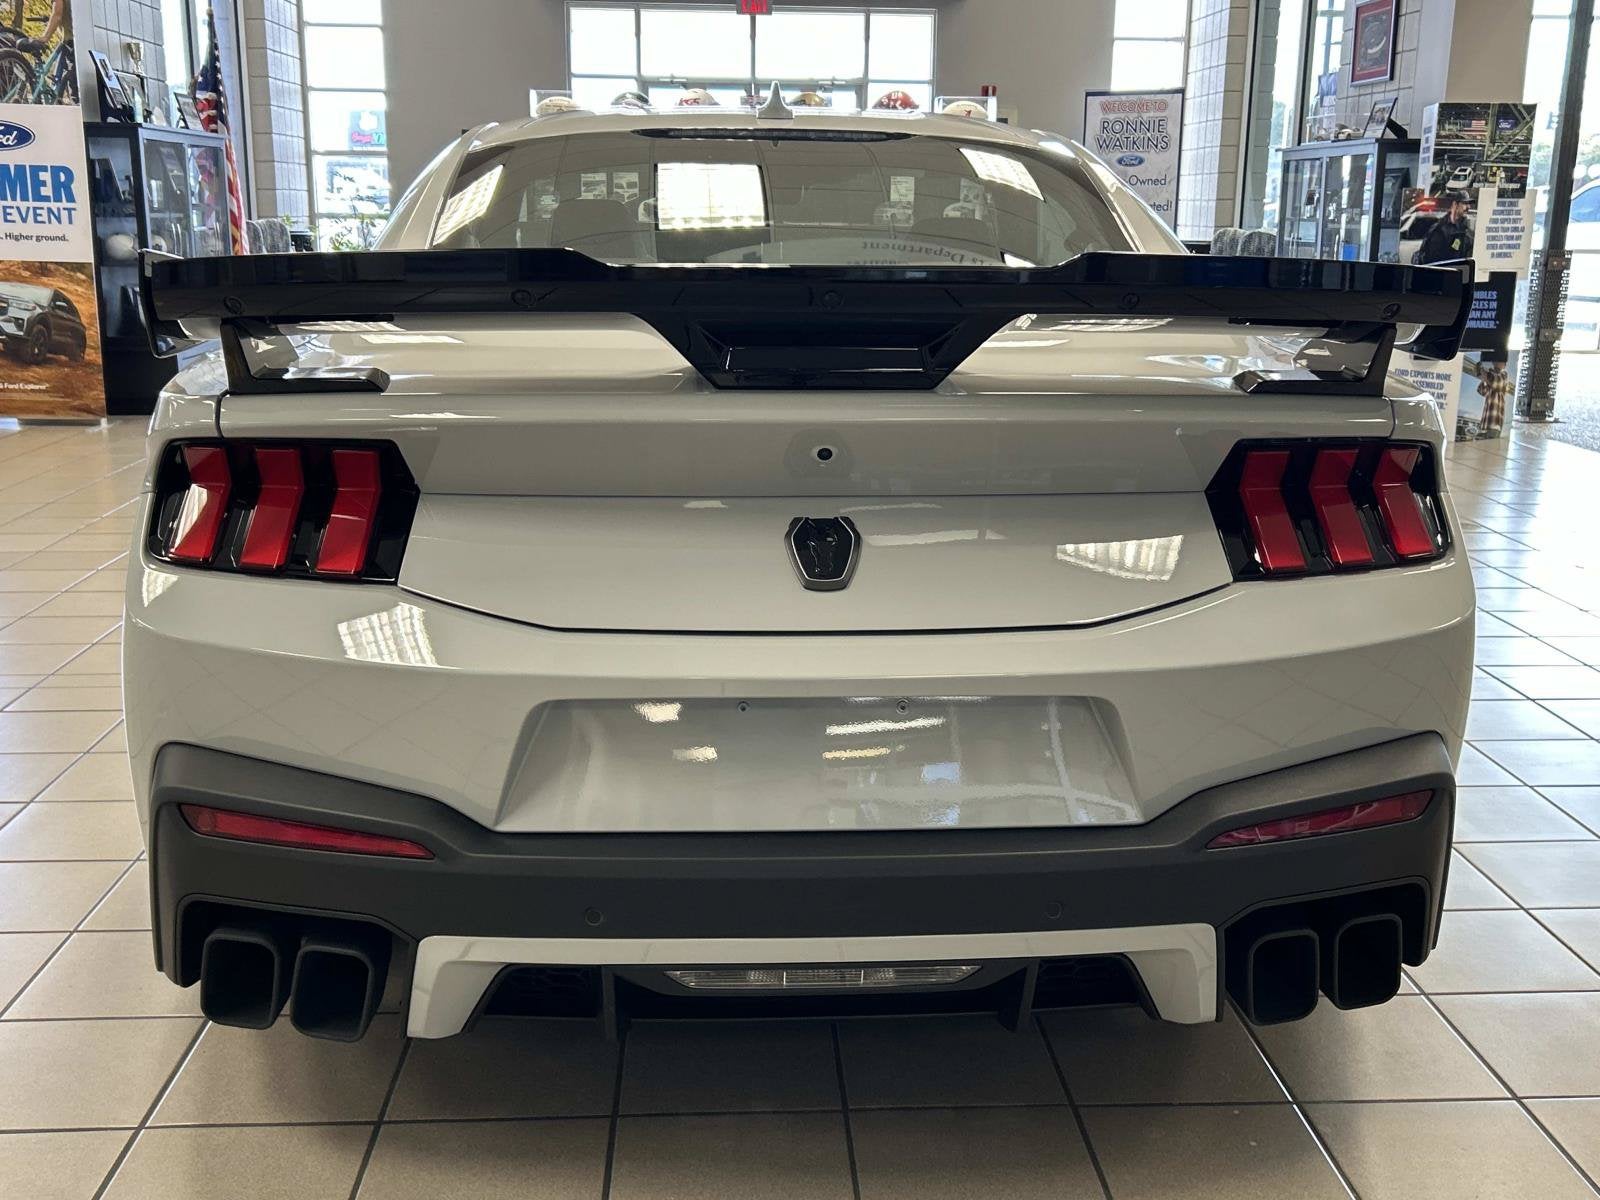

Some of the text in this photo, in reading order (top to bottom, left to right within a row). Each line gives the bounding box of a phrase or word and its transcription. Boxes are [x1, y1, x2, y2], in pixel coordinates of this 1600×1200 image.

[1101, 100, 1168, 113] WELCOME TO
[1101, 118, 1168, 135] RONNIE
[1096, 135, 1169, 151] WATKINS
[2, 205, 77, 225] EVENT
[4, 232, 33, 242] Higher
[862, 240, 964, 264] Department
[1489, 300, 1497, 309] IN
[1482, 310, 1496, 319] ANY
[1410, 369, 1434, 380] EXPORTS
[1436, 372, 1451, 381] MORE
